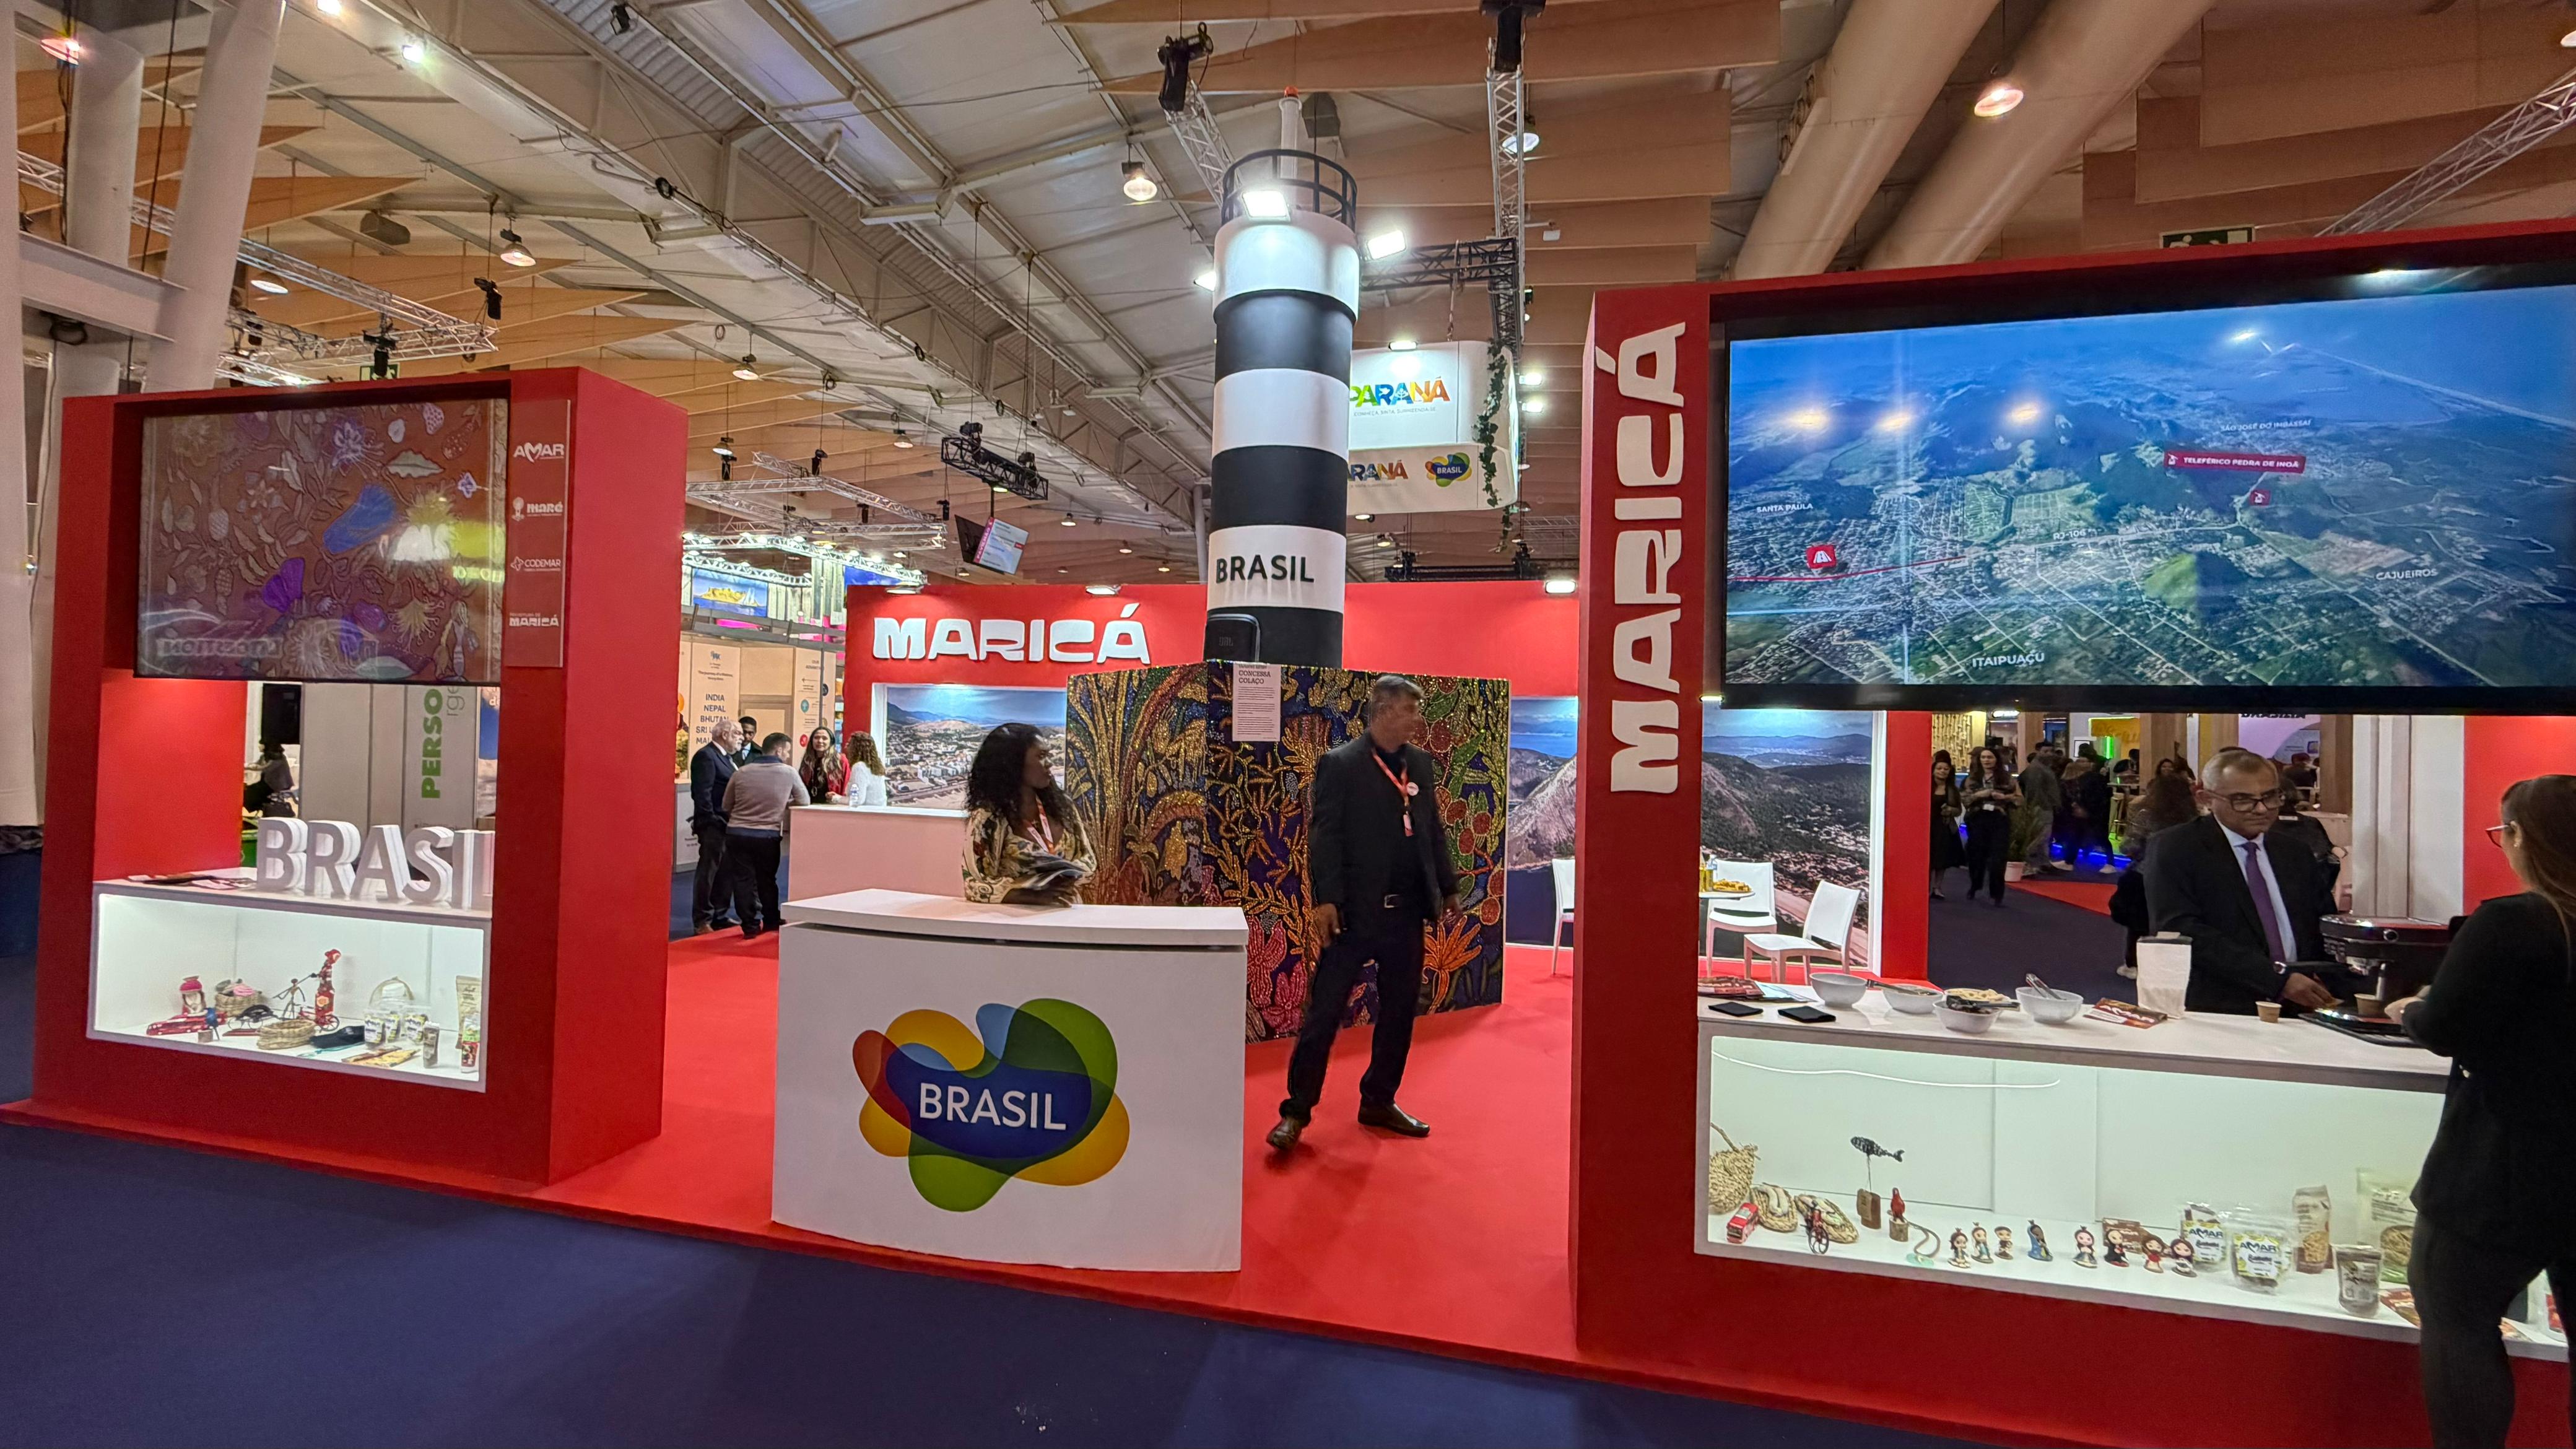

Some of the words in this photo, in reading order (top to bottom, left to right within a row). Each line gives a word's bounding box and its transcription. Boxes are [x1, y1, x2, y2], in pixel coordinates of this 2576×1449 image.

[513, 442, 565, 463] AMAR
[2183, 457, 2230, 465] TELEFÉRICO
[1437, 466, 1463, 474] BRASIL
[1756, 505, 1784, 513] SANTA
[1785, 503, 1813, 511] PAULA
[524, 559, 561, 568] CODEMAR
[1595, 322, 1686, 794] MARICÁ
[1216, 554, 1315, 583] BRASIL
[2375, 568, 2439, 581] CAJUEIROS
[509, 614, 559, 627] MARICÁ
[872, 603, 1151, 664] MARICÁ
[1972, 653, 2045, 668] ITAIPUAÇU
[919, 1083, 1066, 1131] BRASIL
[2188, 1228, 2224, 1239] AMAR
[2240, 1241, 2276, 1253] AMAR
